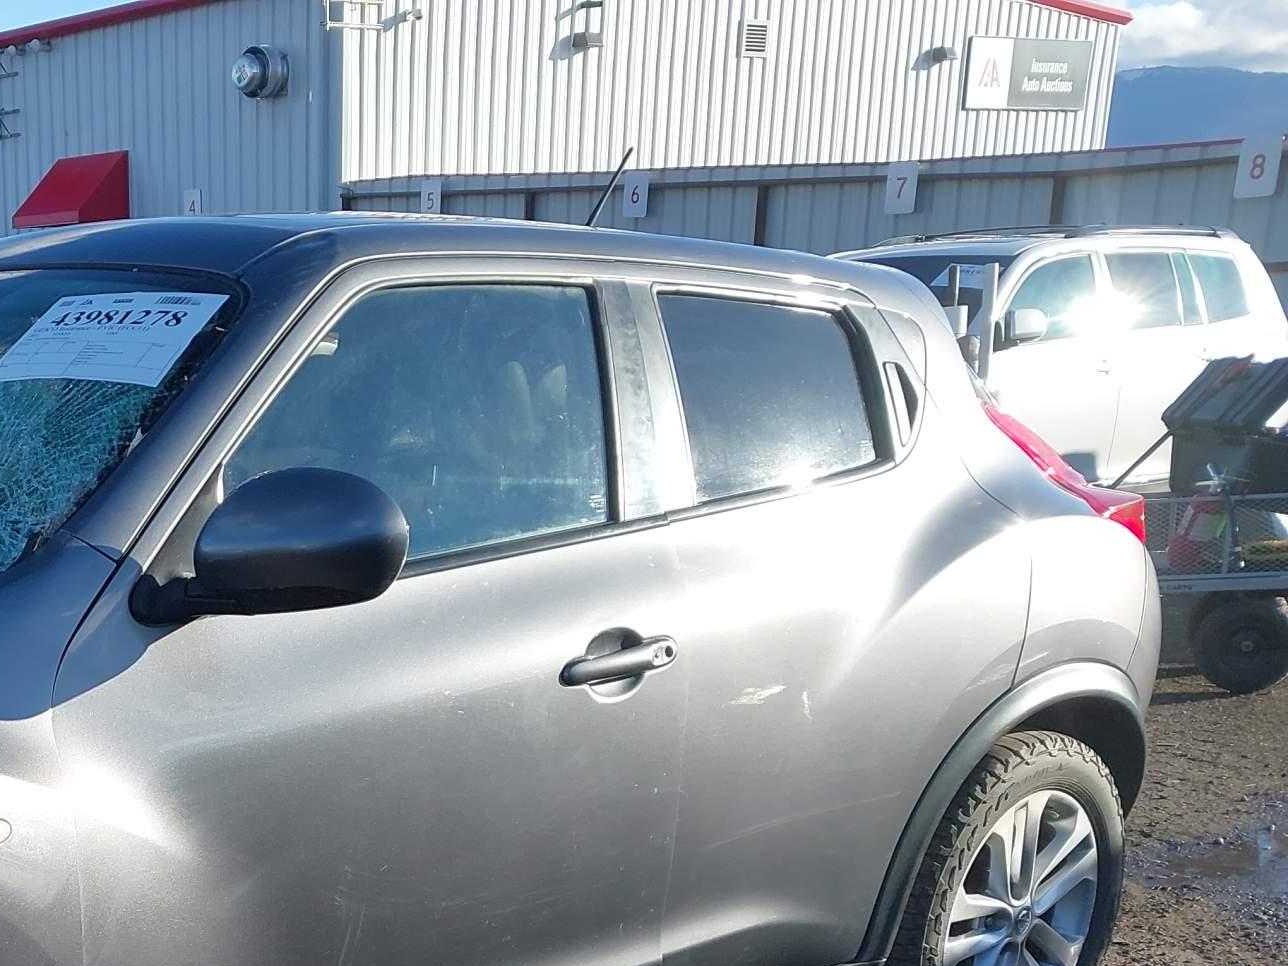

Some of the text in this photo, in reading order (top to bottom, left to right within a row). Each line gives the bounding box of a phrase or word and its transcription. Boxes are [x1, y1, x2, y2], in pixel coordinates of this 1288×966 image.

[1031, 58, 1068, 74] Insurance
[1022, 76, 1073, 93] Auto Auctions
[1249, 153, 1267, 180] 8
[630, 184, 640, 204] 6
[896, 176, 908, 200] 7
[188, 199, 196, 216] 4
[427, 192, 434, 210] 5
[50, 309, 189, 328] 43981278
